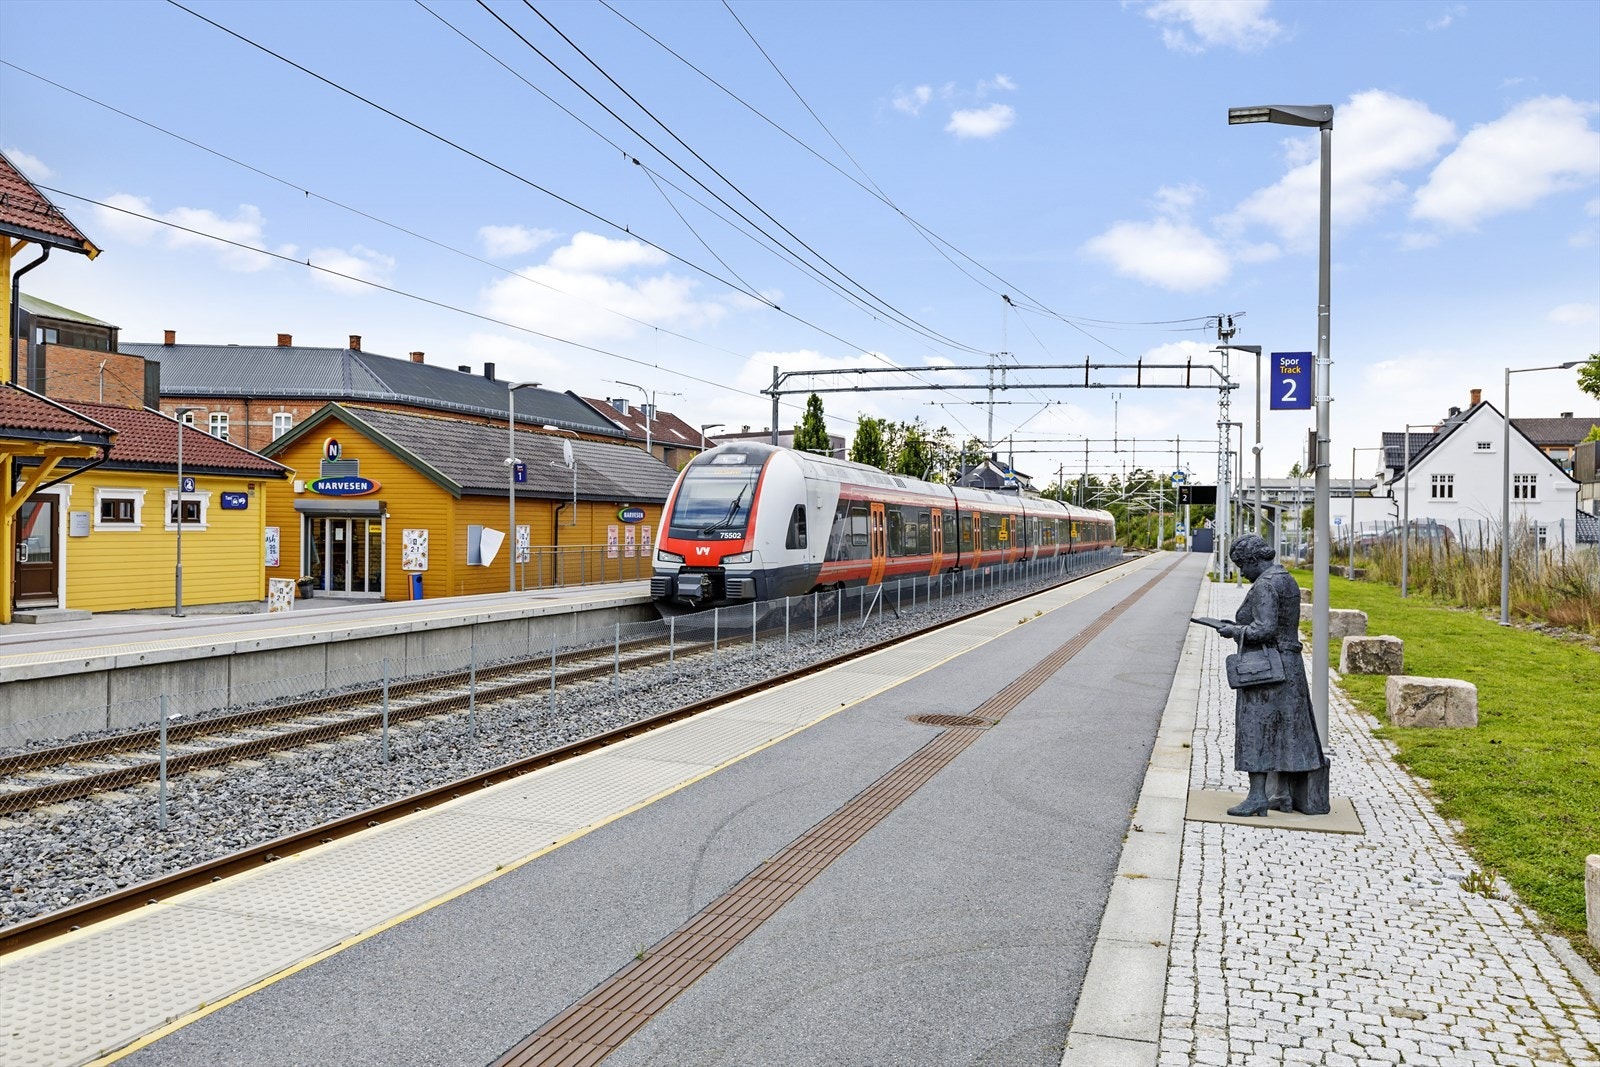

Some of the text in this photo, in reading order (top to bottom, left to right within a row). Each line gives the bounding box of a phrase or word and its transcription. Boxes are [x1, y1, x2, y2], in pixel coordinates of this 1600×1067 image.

[1280, 357, 1299, 367] Spor
[1281, 378, 1297, 402] 2
[329, 444, 337, 456] N
[518, 472, 522, 480] 1
